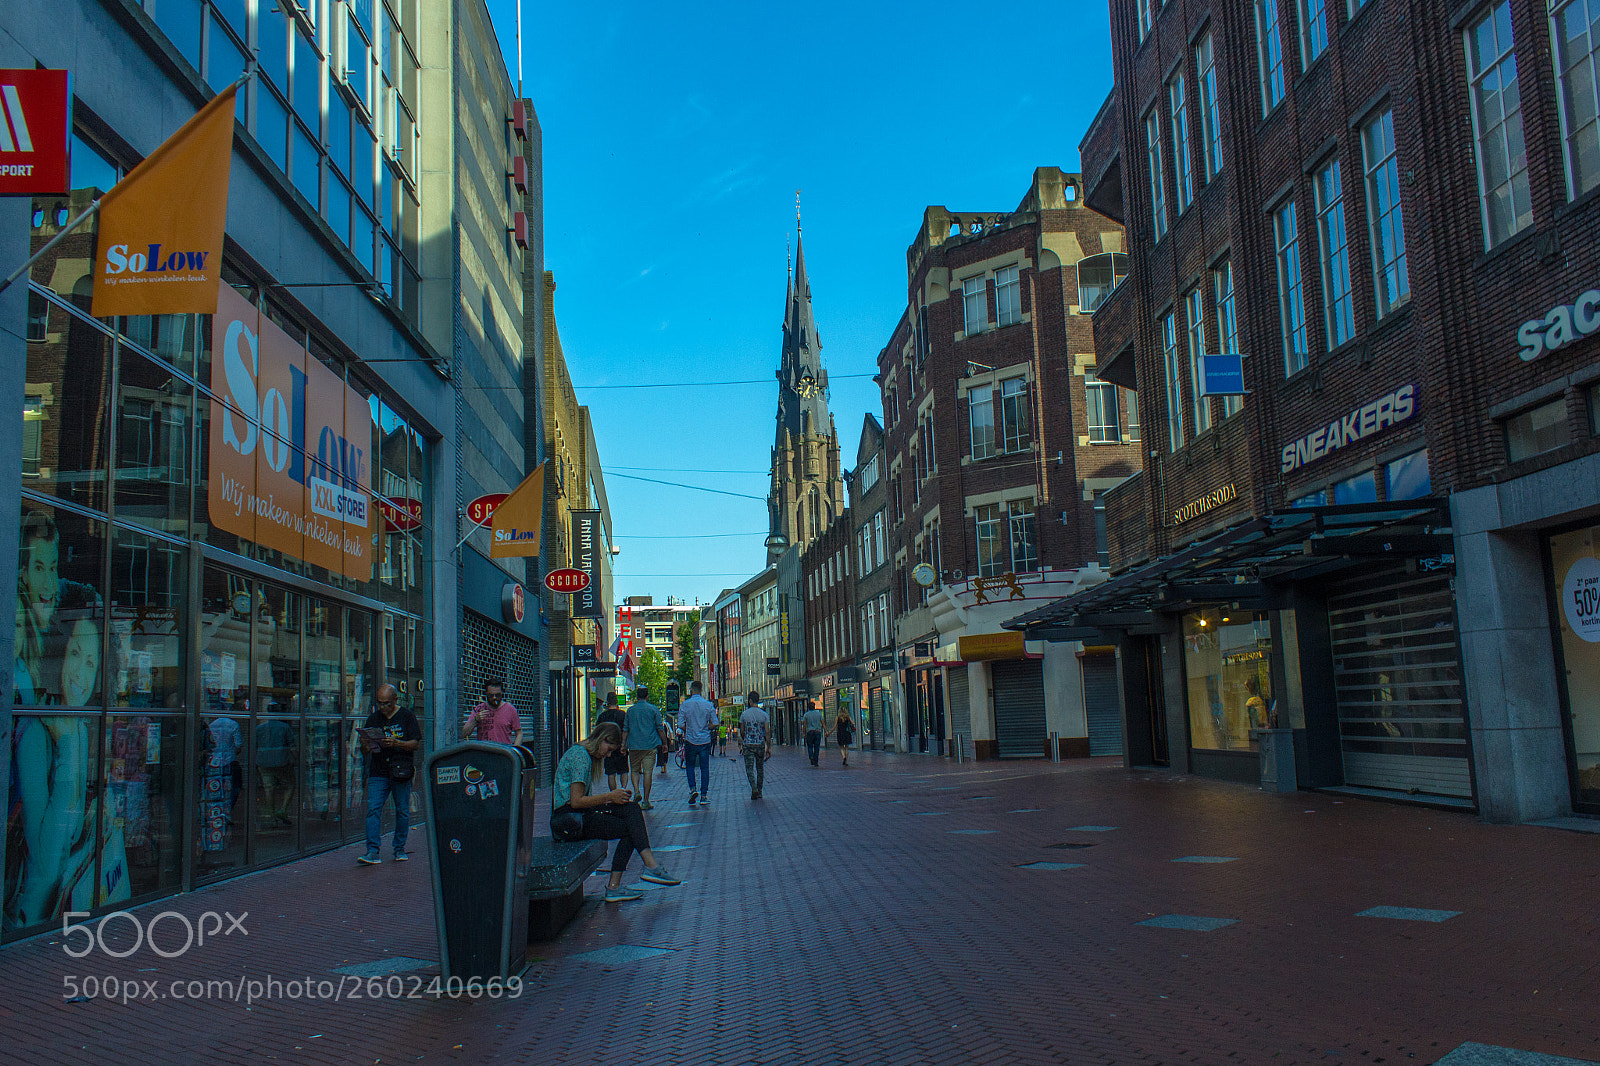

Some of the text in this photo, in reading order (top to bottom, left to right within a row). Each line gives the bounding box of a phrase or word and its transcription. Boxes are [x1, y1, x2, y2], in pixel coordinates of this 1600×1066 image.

[105, 243, 210, 274] SoLow
[119, 276, 148, 285] maken
[1282, 384, 1414, 474] SNEAKERS
[221, 472, 363, 558] Wij maken winkelen leuk
[315, 483, 366, 521] XXL STORE!
[1174, 482, 1237, 525] SCOTCH&SODA
[550, 574, 586, 587] SCORE
[619, 606, 633, 656] HEM
